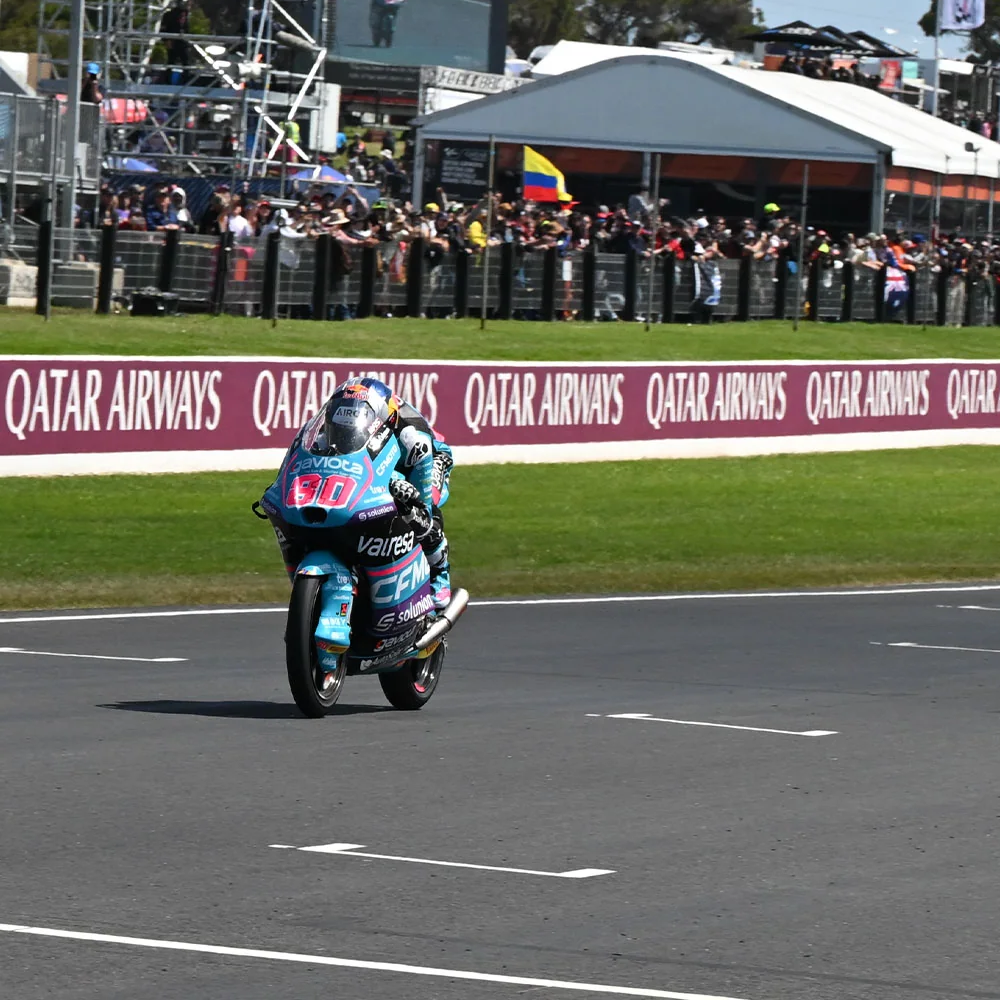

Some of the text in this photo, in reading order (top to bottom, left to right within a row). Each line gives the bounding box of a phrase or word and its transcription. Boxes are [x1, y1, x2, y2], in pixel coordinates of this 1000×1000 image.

[5, 368, 222, 440] QATAR AIRWAYS
[464, 372, 536, 434] QATAR
[538, 373, 624, 425] AIRWAYS
[646, 371, 787, 429] QATAR AIRWAYS
[806, 370, 930, 425] QATAR AIRWAYS
[946, 369, 997, 420] QATAR
[286, 473, 357, 509] 80
[290, 457, 363, 476] gaviota
[367, 505, 394, 518] solunion
[396, 594, 434, 625] solunion
